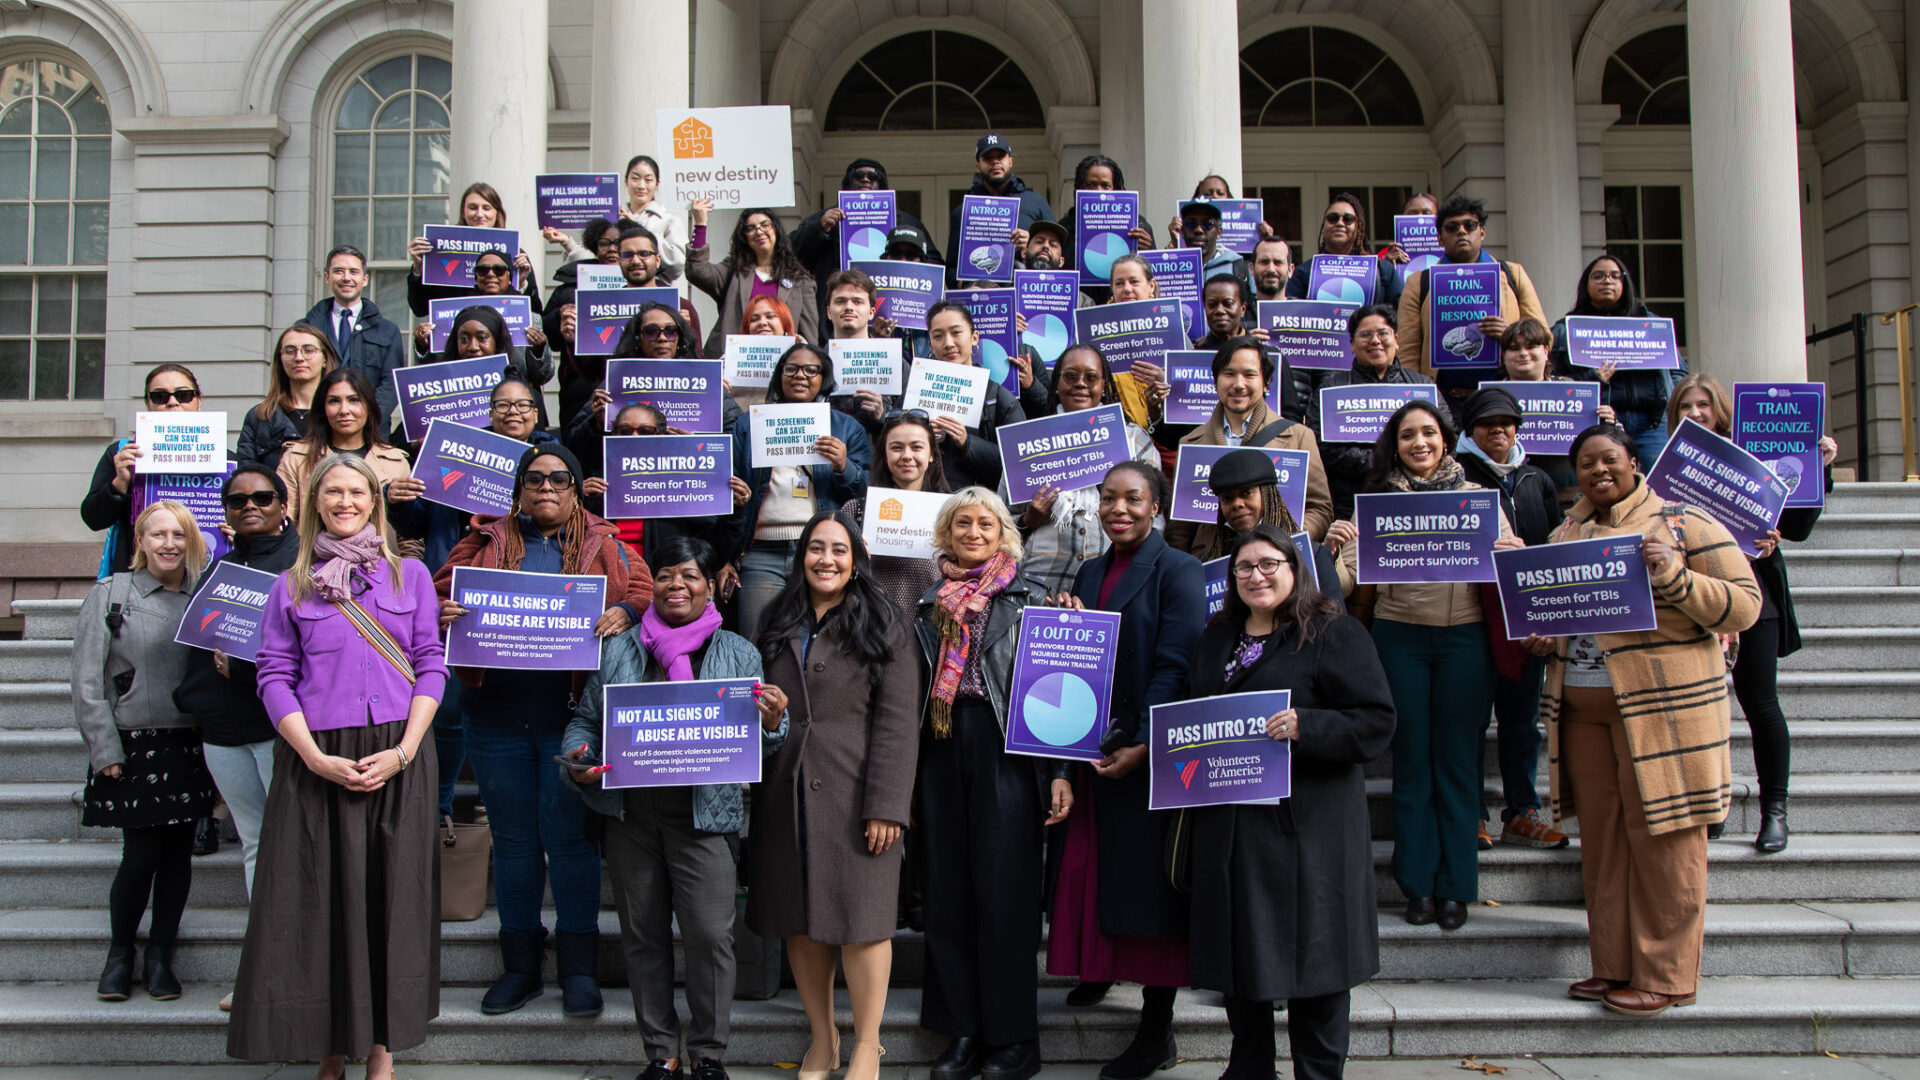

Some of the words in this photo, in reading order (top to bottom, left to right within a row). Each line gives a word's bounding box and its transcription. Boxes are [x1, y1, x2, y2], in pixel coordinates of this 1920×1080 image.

[675, 171, 711, 183] new
[715, 166, 778, 185] destiny
[552, 197, 573, 206] ABUSE
[574, 197, 587, 206] ARE
[588, 197, 613, 206] VISIBLE
[676, 187, 740, 204] housing
[970, 206, 996, 216] INTRO
[998, 207, 1010, 216] 29
[1083, 203, 1089, 212] 4
[1091, 203, 1110, 212] OUT
[1111, 203, 1123, 212] OF
[1124, 203, 1131, 213] 5
[436, 238, 462, 250] PASS
[463, 241, 492, 252] INTRO
[1448, 280, 1482, 291] TRAIN.
[1438, 295, 1493, 306] RECOGNIZE.
[590, 304, 618, 316] PASS
[1441, 310, 1487, 321] RESPOND
[1090, 321, 1119, 338] PASS
[1120, 318, 1153, 333] INTRO
[1154, 316, 1169, 328] 29
[1273, 316, 1300, 328] PASS
[1301, 316, 1332, 330] INTRO
[1334, 318, 1348, 330] 29
[408, 380, 442, 398] PASS
[444, 376, 482, 394] INTRO
[484, 372, 502, 386] 29
[622, 376, 652, 390] PASS
[654, 376, 690, 390] INTRO
[691, 378, 708, 390] 29
[1756, 402, 1800, 415] TRAIN.
[154, 426, 165, 434] TBI
[166, 426, 210, 434] SCREENINGS
[1742, 422, 1813, 434] RECOGNIZE.
[164, 434, 180, 442] CAN
[182, 434, 199, 442] SAVE
[1017, 436, 1051, 456] PASS
[1051, 430, 1091, 450] INTRO
[1092, 426, 1110, 442] 29
[152, 442, 194, 452] SURVIVORS'
[196, 443, 216, 452] LIVES
[1745, 440, 1807, 454] RESPOND.
[153, 454, 172, 463] PASS
[174, 454, 196, 463] INTRO
[198, 454, 212, 463] 29!
[440, 439, 475, 460] PASS
[474, 448, 515, 473] INTRO
[622, 456, 656, 470] PASS
[657, 456, 696, 470] INTRO
[698, 456, 716, 469] 29
[1030, 458, 1066, 473] Screen
[1066, 456, 1082, 468] for
[1082, 450, 1106, 463] TBIs
[1025, 471, 1068, 488] Support
[1068, 460, 1114, 478] survivors
[1676, 442, 1700, 460] NOT
[1695, 453, 1716, 471] ALL
[1714, 462, 1748, 488] SIGNS
[1745, 480, 1762, 495] OF
[160, 474, 202, 488] INTRO
[204, 476, 223, 490] 29
[631, 480, 667, 490] Screen
[668, 480, 684, 490] for
[684, 479, 707, 489] TBIs
[624, 494, 666, 505] Support
[667, 493, 714, 502] survivors
[1681, 464, 1717, 490] ABUSE
[1712, 482, 1736, 502] ARE
[1734, 494, 1774, 523] VISIBLE
[1375, 516, 1412, 532] PASS
[1414, 514, 1458, 531] INTRO
[1460, 514, 1480, 529] 29
[876, 526, 898, 536] new
[876, 537, 914, 550] housing
[1386, 542, 1426, 552] Screen
[1426, 540, 1444, 552] for
[1446, 540, 1471, 550] TBIs
[1378, 556, 1424, 568] Support
[1426, 555, 1480, 566] survivors
[1516, 568, 1555, 587] PASS
[1556, 564, 1604, 584] INTRO
[1605, 560, 1628, 577] 29
[212, 582, 239, 600] PASS
[237, 589, 268, 607] INTRO
[464, 592, 488, 606] NOT
[489, 594, 511, 609] ALL
[512, 596, 548, 611] SIGNS
[550, 598, 566, 611] OF
[1531, 595, 1572, 608] Screen
[1573, 592, 1591, 604] for
[1592, 590, 1620, 602] TBIs
[224, 612, 258, 629] Volunteers
[1526, 610, 1574, 623] Support
[1574, 604, 1632, 619] survivors
[481, 612, 520, 628] ABUSE
[522, 614, 546, 629] ARE
[546, 616, 592, 630] VISIBLE
[1030, 626, 1040, 638] 4
[1042, 626, 1073, 640] OUT
[1074, 629, 1094, 642] OF
[1095, 631, 1106, 644] 5
[1030, 642, 1065, 652] SURVIVORS
[1066, 645, 1104, 655] EXPERIENCE
[1031, 650, 1060, 660] INJURIES
[1060, 653, 1101, 662] CONSISTENT
[1050, 660, 1070, 668] BRAIN
[1070, 662, 1098, 670] TRAUMA
[618, 710, 642, 724] NOT
[642, 708, 664, 723] ALL
[666, 707, 702, 722] SIGNS
[704, 706, 720, 720] OF
[636, 728, 676, 743] ABUSE
[677, 726, 701, 741] ARE
[702, 724, 748, 740] VISIBLE
[1166, 724, 1200, 745] PASS
[1202, 718, 1245, 742] INTRO
[1246, 716, 1266, 736] 29
[653, 748, 682, 756] domestic
[683, 747, 712, 755] violence
[712, 746, 742, 754] survivors
[634, 757, 669, 766] experience
[670, 756, 693, 766] injuries
[1206, 755, 1261, 769] Volunteers
[653, 766, 667, 774] with
[686, 764, 710, 772] trauma
[1208, 768, 1218, 779] of
[1208, 780, 1232, 788] GREATER
[1232, 778, 1246, 786] NEW
[1247, 777, 1263, 785] YORK
